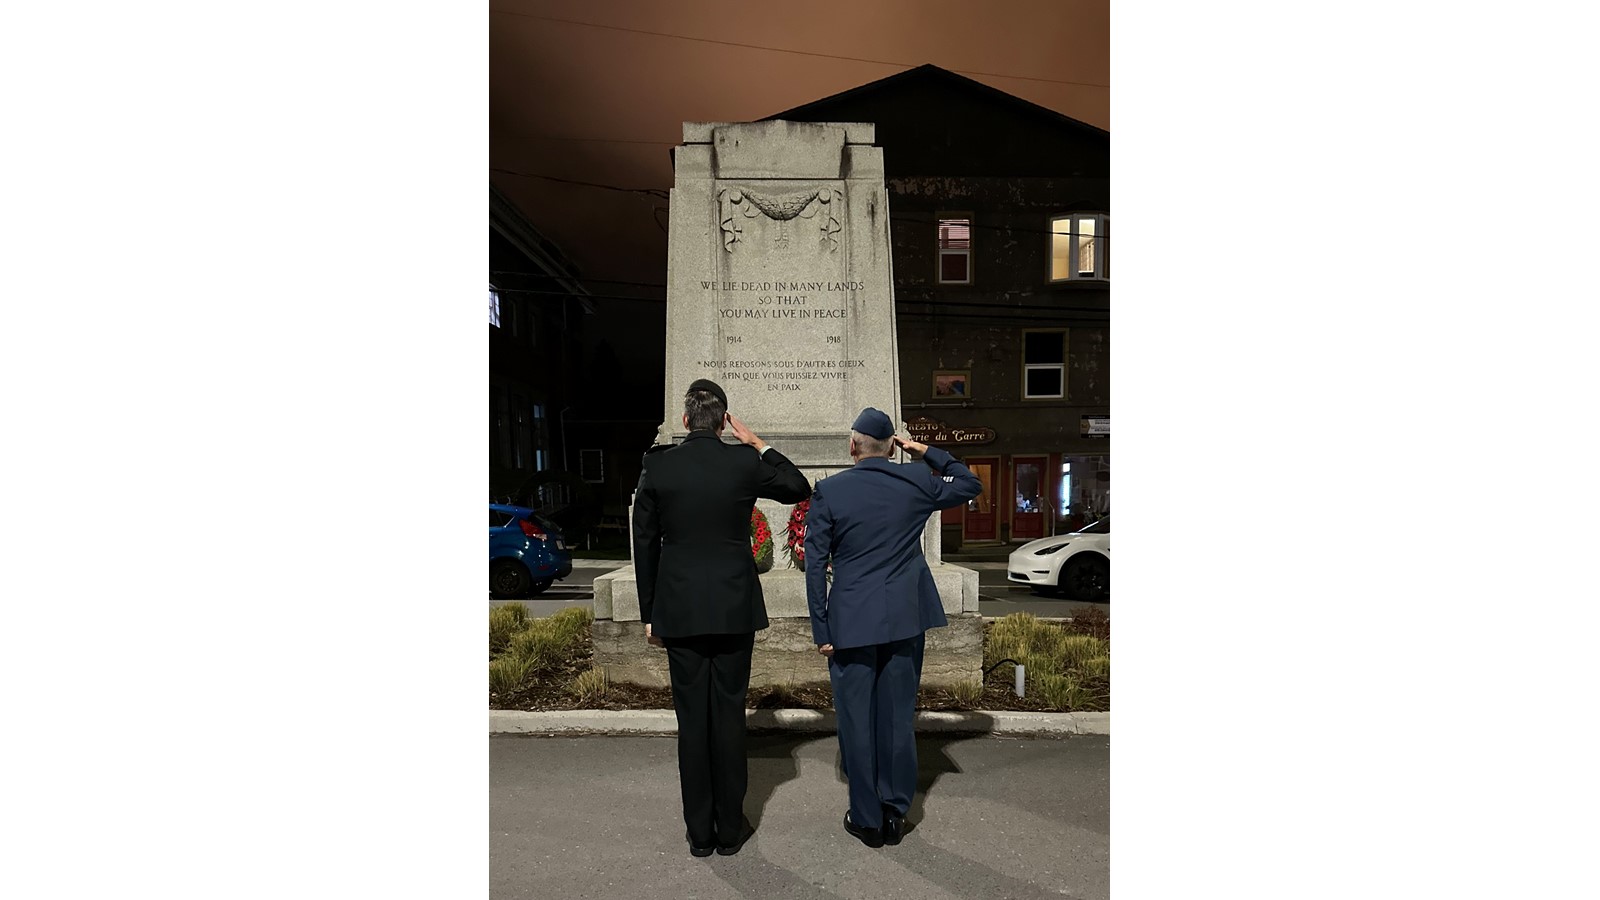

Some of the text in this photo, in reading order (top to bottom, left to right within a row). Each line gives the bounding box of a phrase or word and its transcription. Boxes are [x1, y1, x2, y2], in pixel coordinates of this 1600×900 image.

[701, 281, 865, 292] WE LIE DEAD IN MANY LANDS
[758, 295, 808, 305] SO THAT
[719, 309, 847, 319] YOU MAY LIVE IN PEACE
[726, 336, 742, 344] 1914
[826, 336, 841, 344] 1918
[703, 360, 865, 369] NOUS REPOSONS SOUS D'AUTRES CIEUX
[721, 372, 848, 382] AFIN QUE VOUS PUISSIEZ VIVRE
[935, 432, 947, 441] du
